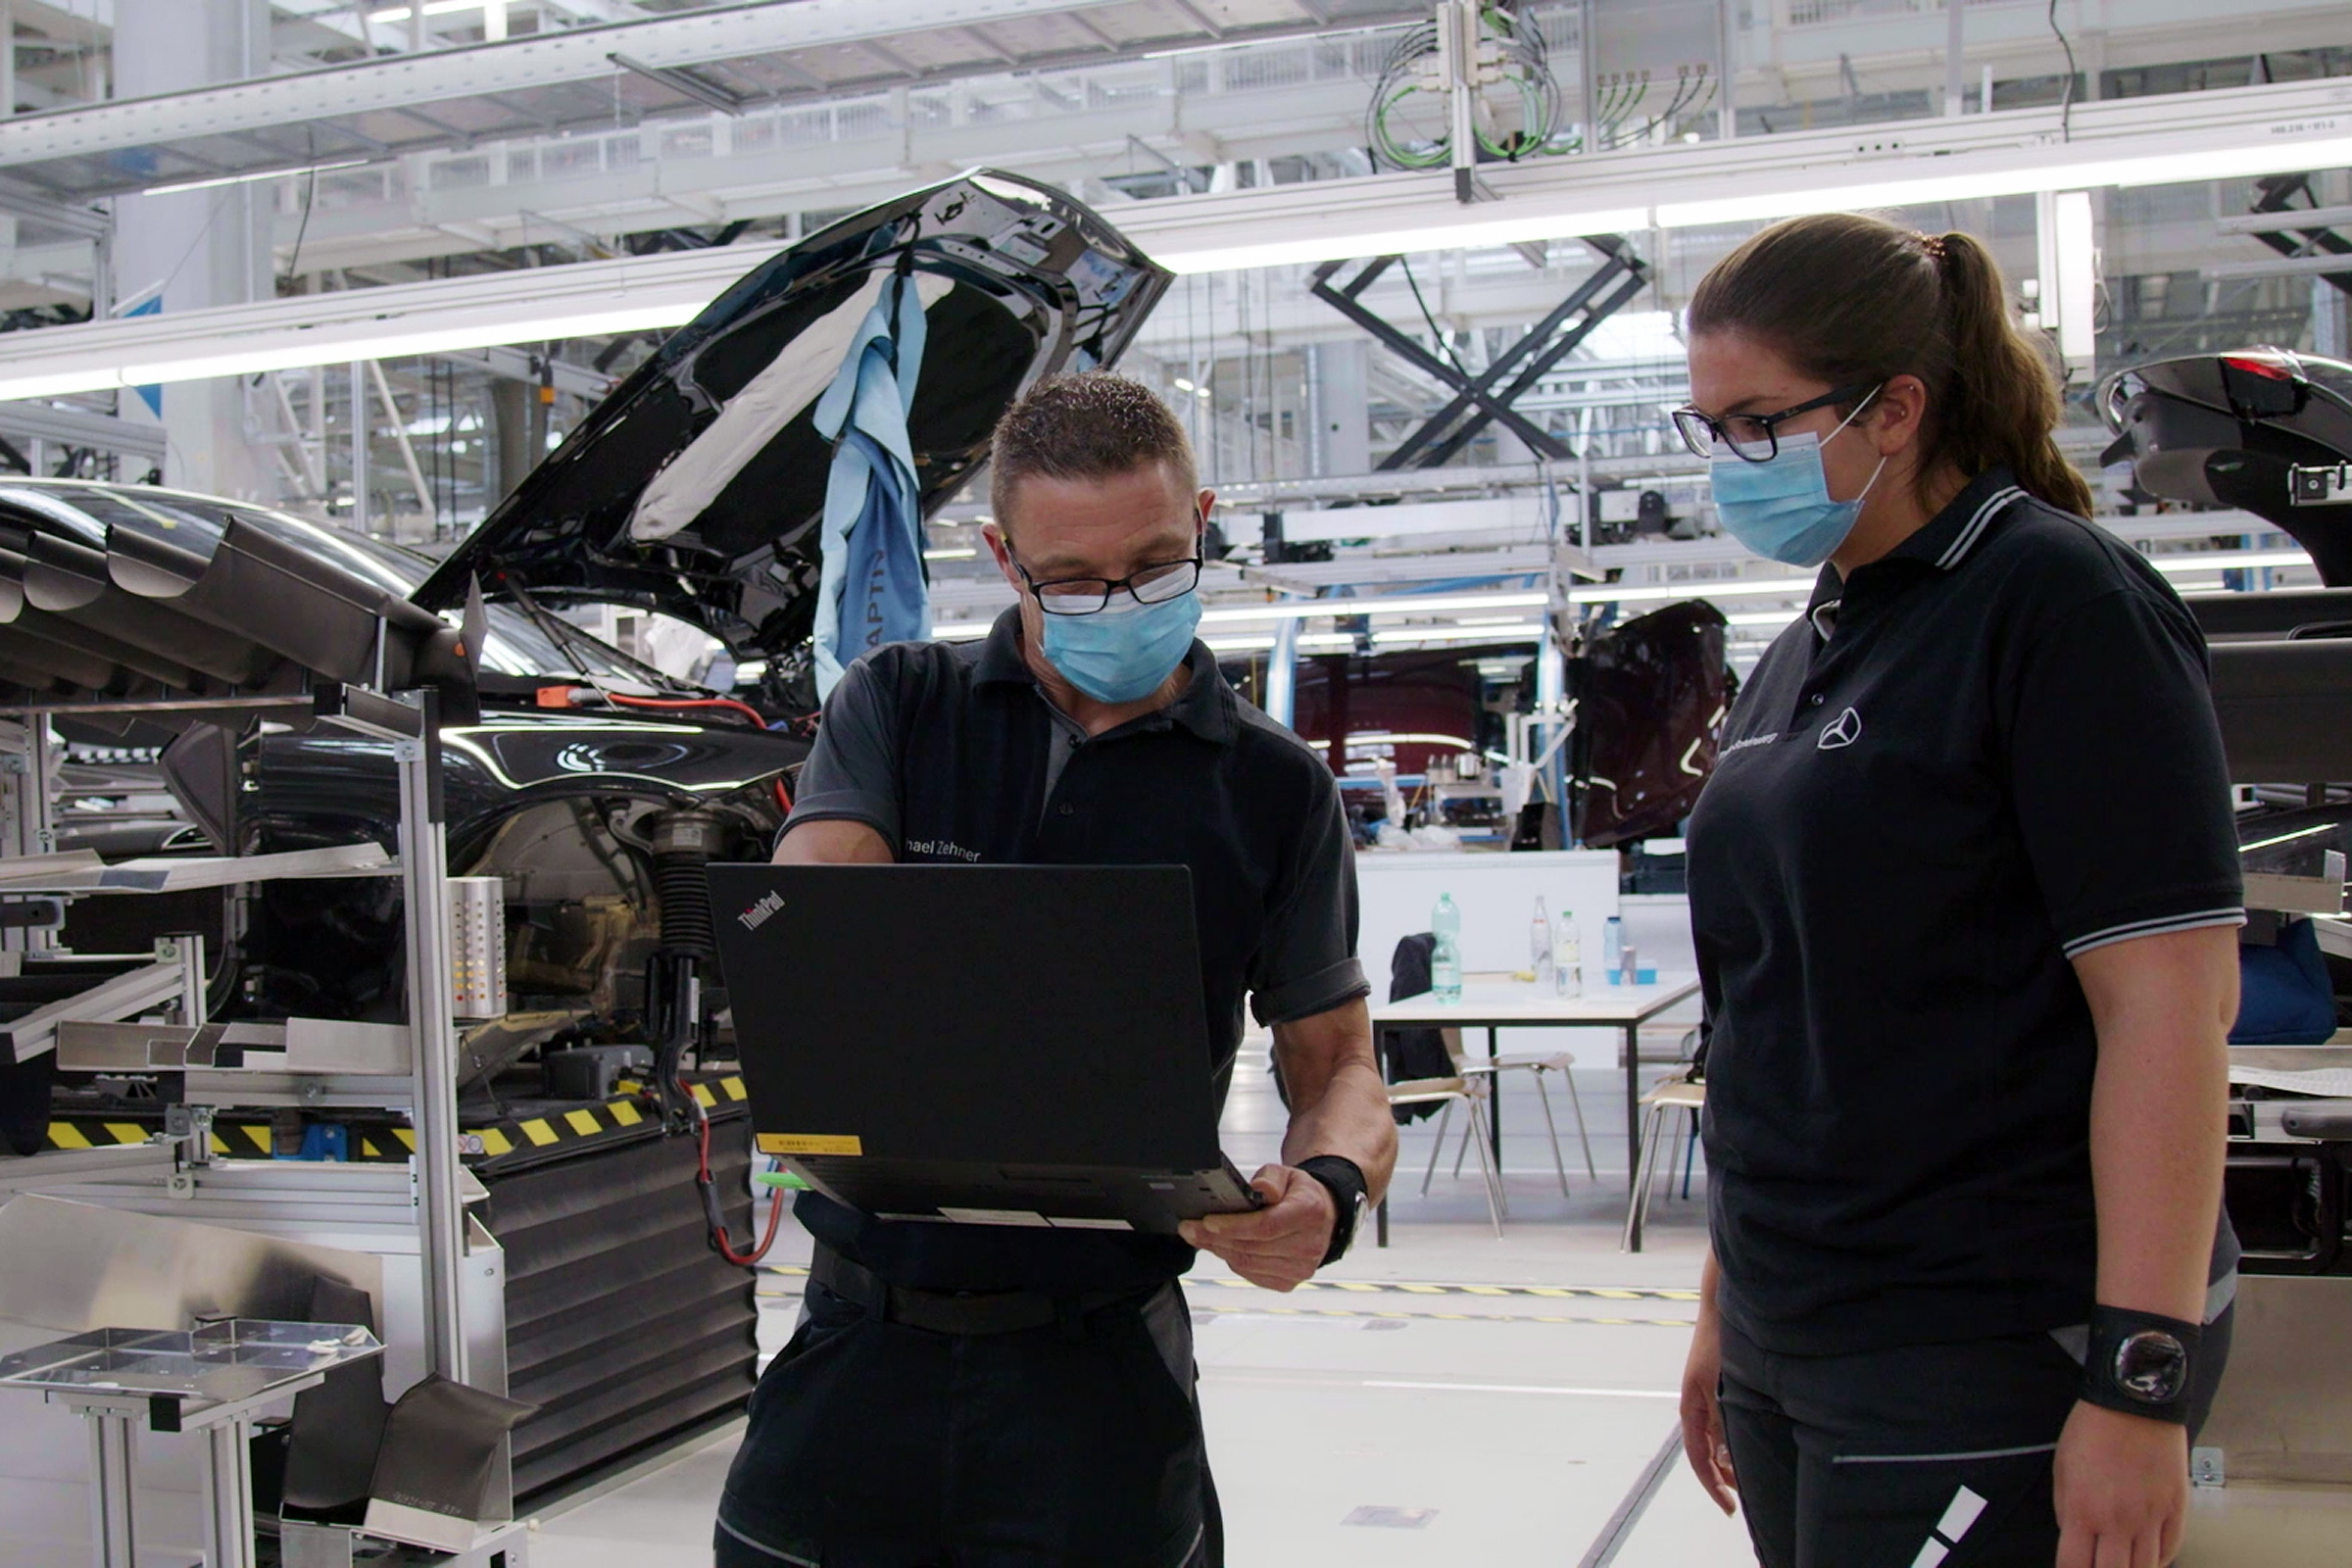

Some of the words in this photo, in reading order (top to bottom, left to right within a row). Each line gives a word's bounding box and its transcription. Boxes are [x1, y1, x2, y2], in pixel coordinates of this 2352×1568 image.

[906, 837, 935, 854] hael
[936, 841, 981, 862] Zehner
[737, 889, 785, 931] ThinkPad
